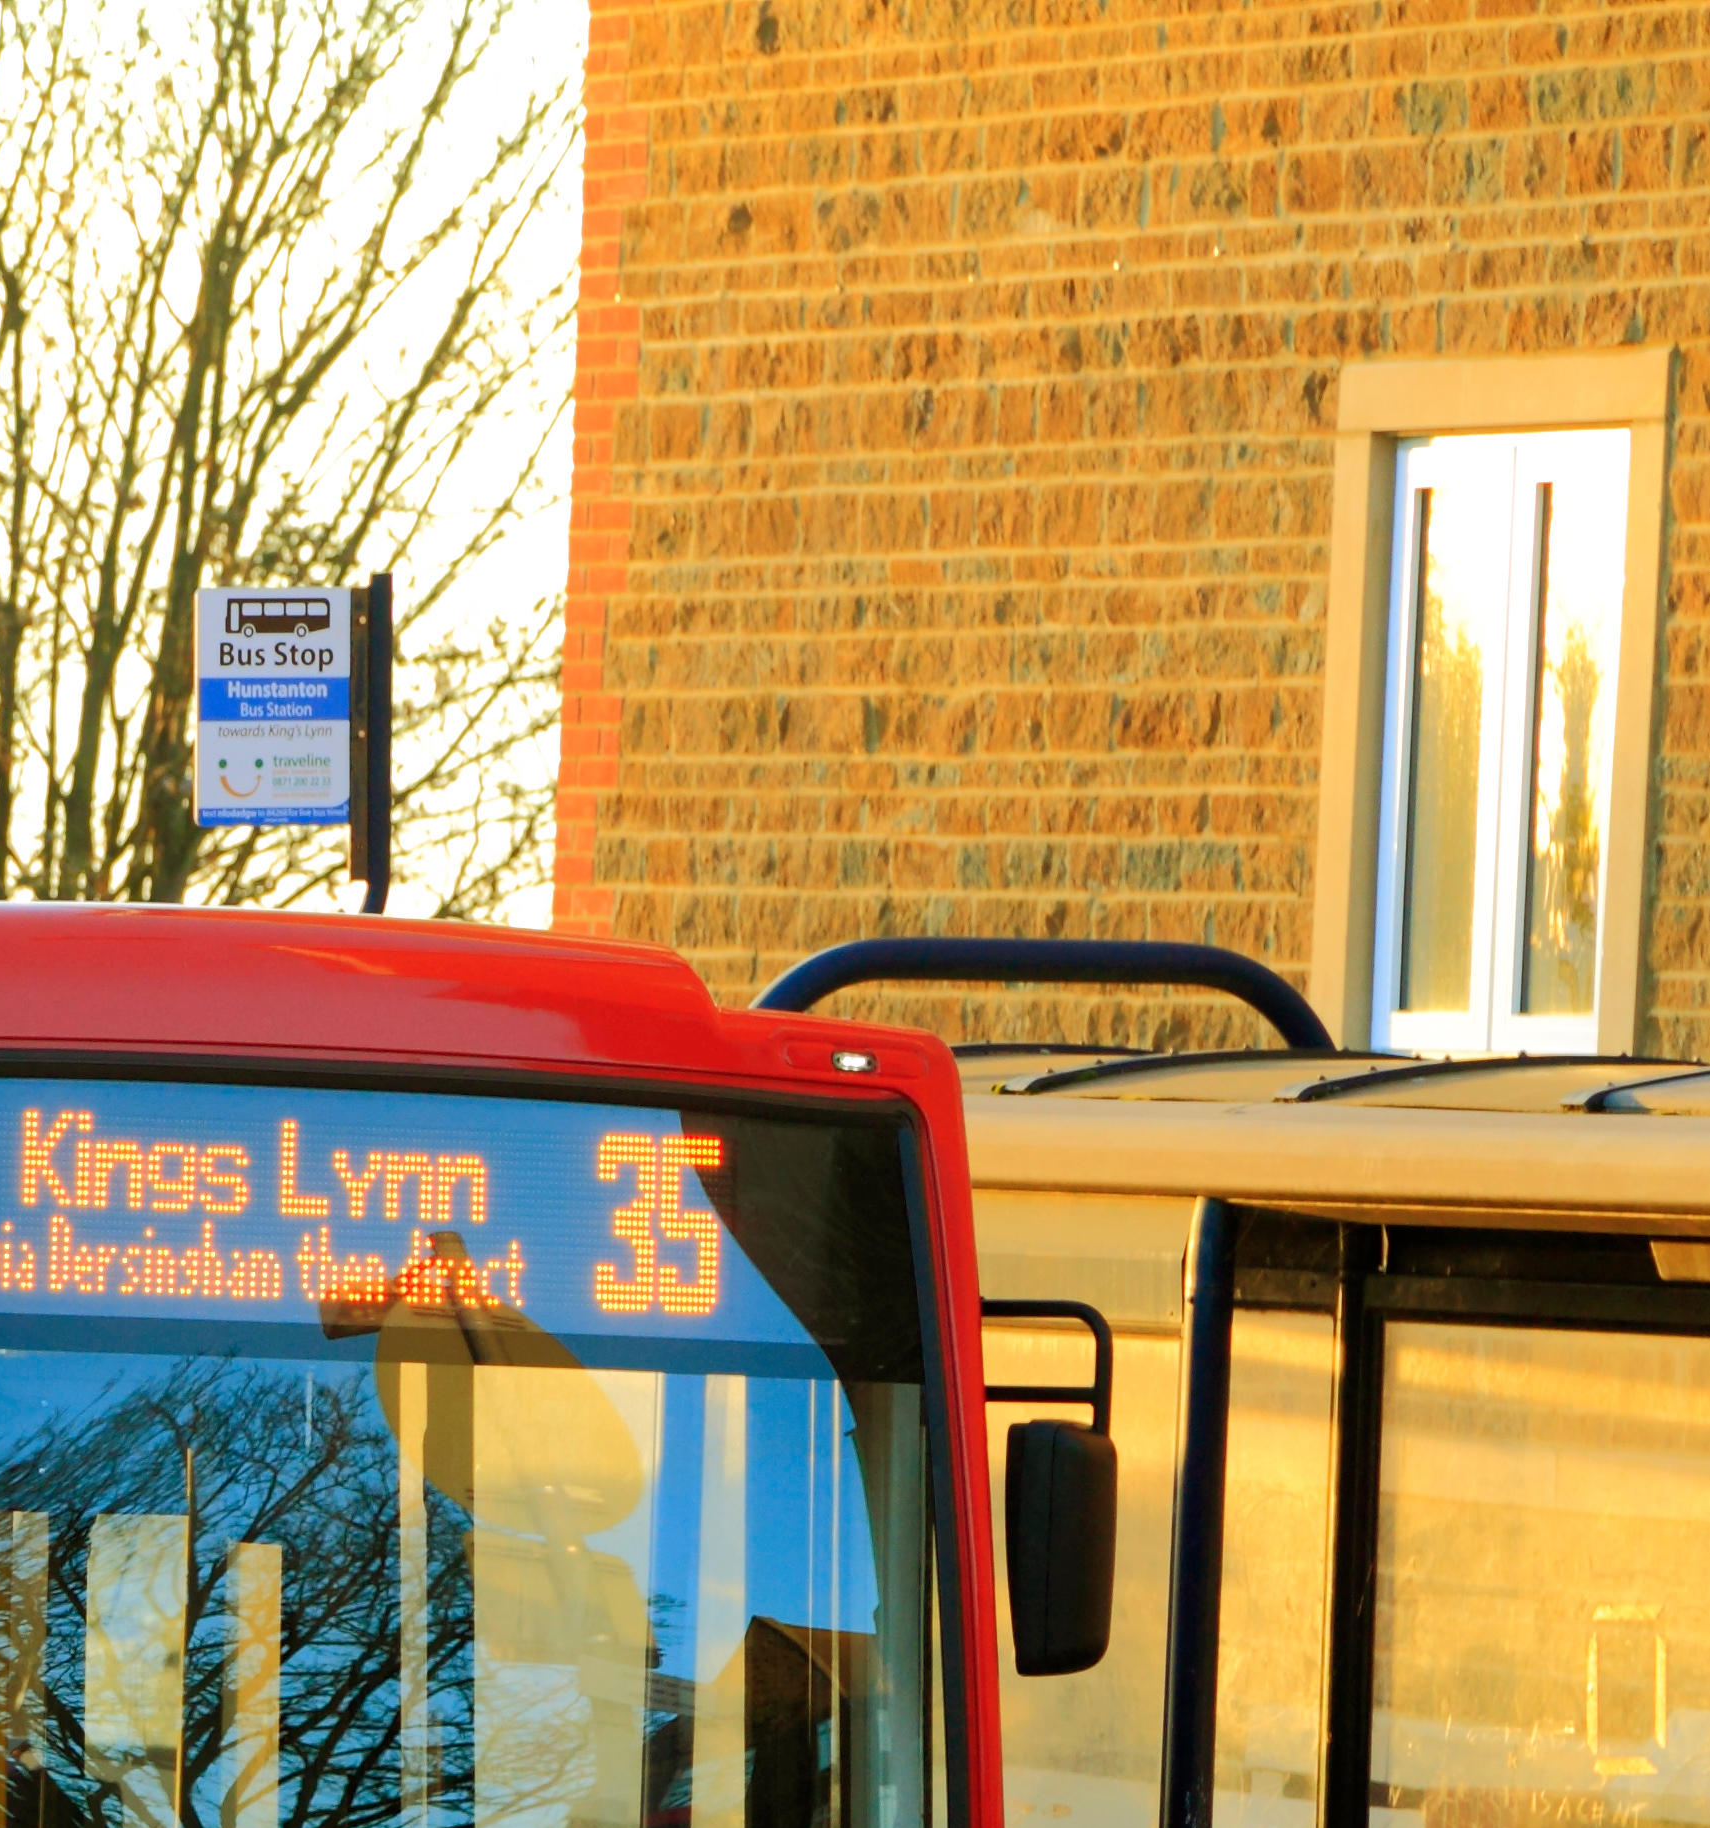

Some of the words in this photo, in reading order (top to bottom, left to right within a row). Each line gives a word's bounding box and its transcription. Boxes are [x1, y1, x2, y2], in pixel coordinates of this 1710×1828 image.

[219, 642, 266, 667] Bus
[274, 642, 334, 672] Stop
[227, 680, 328, 699] Hunstanton
[239, 702, 265, 717] Bus
[266, 702, 313, 718] Station
[218, 725, 265, 738] towards
[268, 725, 302, 741] King's
[305, 725, 333, 740] Lynn
[273, 754, 331, 768] traveline
[19, 1108, 250, 1214] Kings
[278, 1117, 489, 1224] Lynn
[594, 1132, 723, 1316] 35
[296, 1226, 387, 1303] then
[397, 1228, 526, 1308] direct
